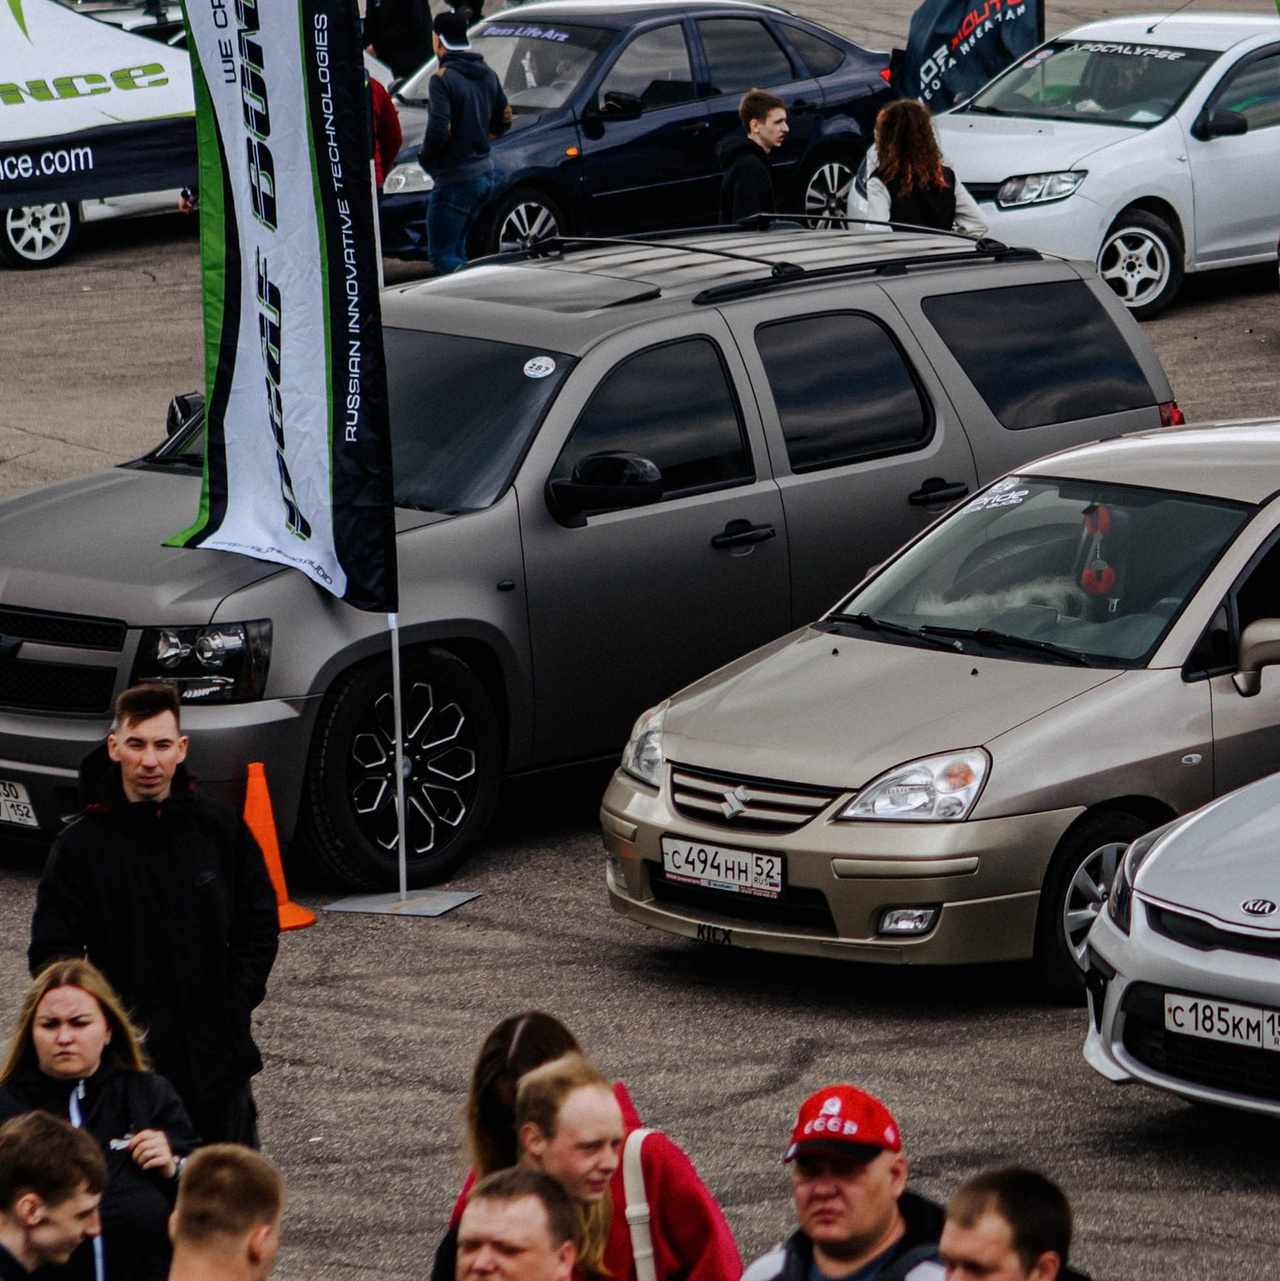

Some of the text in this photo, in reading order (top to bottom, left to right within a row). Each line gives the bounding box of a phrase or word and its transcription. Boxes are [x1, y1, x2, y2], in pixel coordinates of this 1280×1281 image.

[514, 26, 542, 38] Life
[217, 38, 237, 84] WE
[1066, 43, 1186, 61] APOCALYPSE
[314, 13, 361, 442] RUSSIAN INNOVATIVE TECHNOLOGIES
[10, 803, 32, 819] 152
[671, 846, 749, 882] С494НН
[755, 856, 775, 880] 52
[753, 876, 769, 886] RUS
[1244, 899, 1272, 914] KIA
[1172, 1002, 1262, 1043] С185КМ
[803, 1116, 858, 1135] СССР
